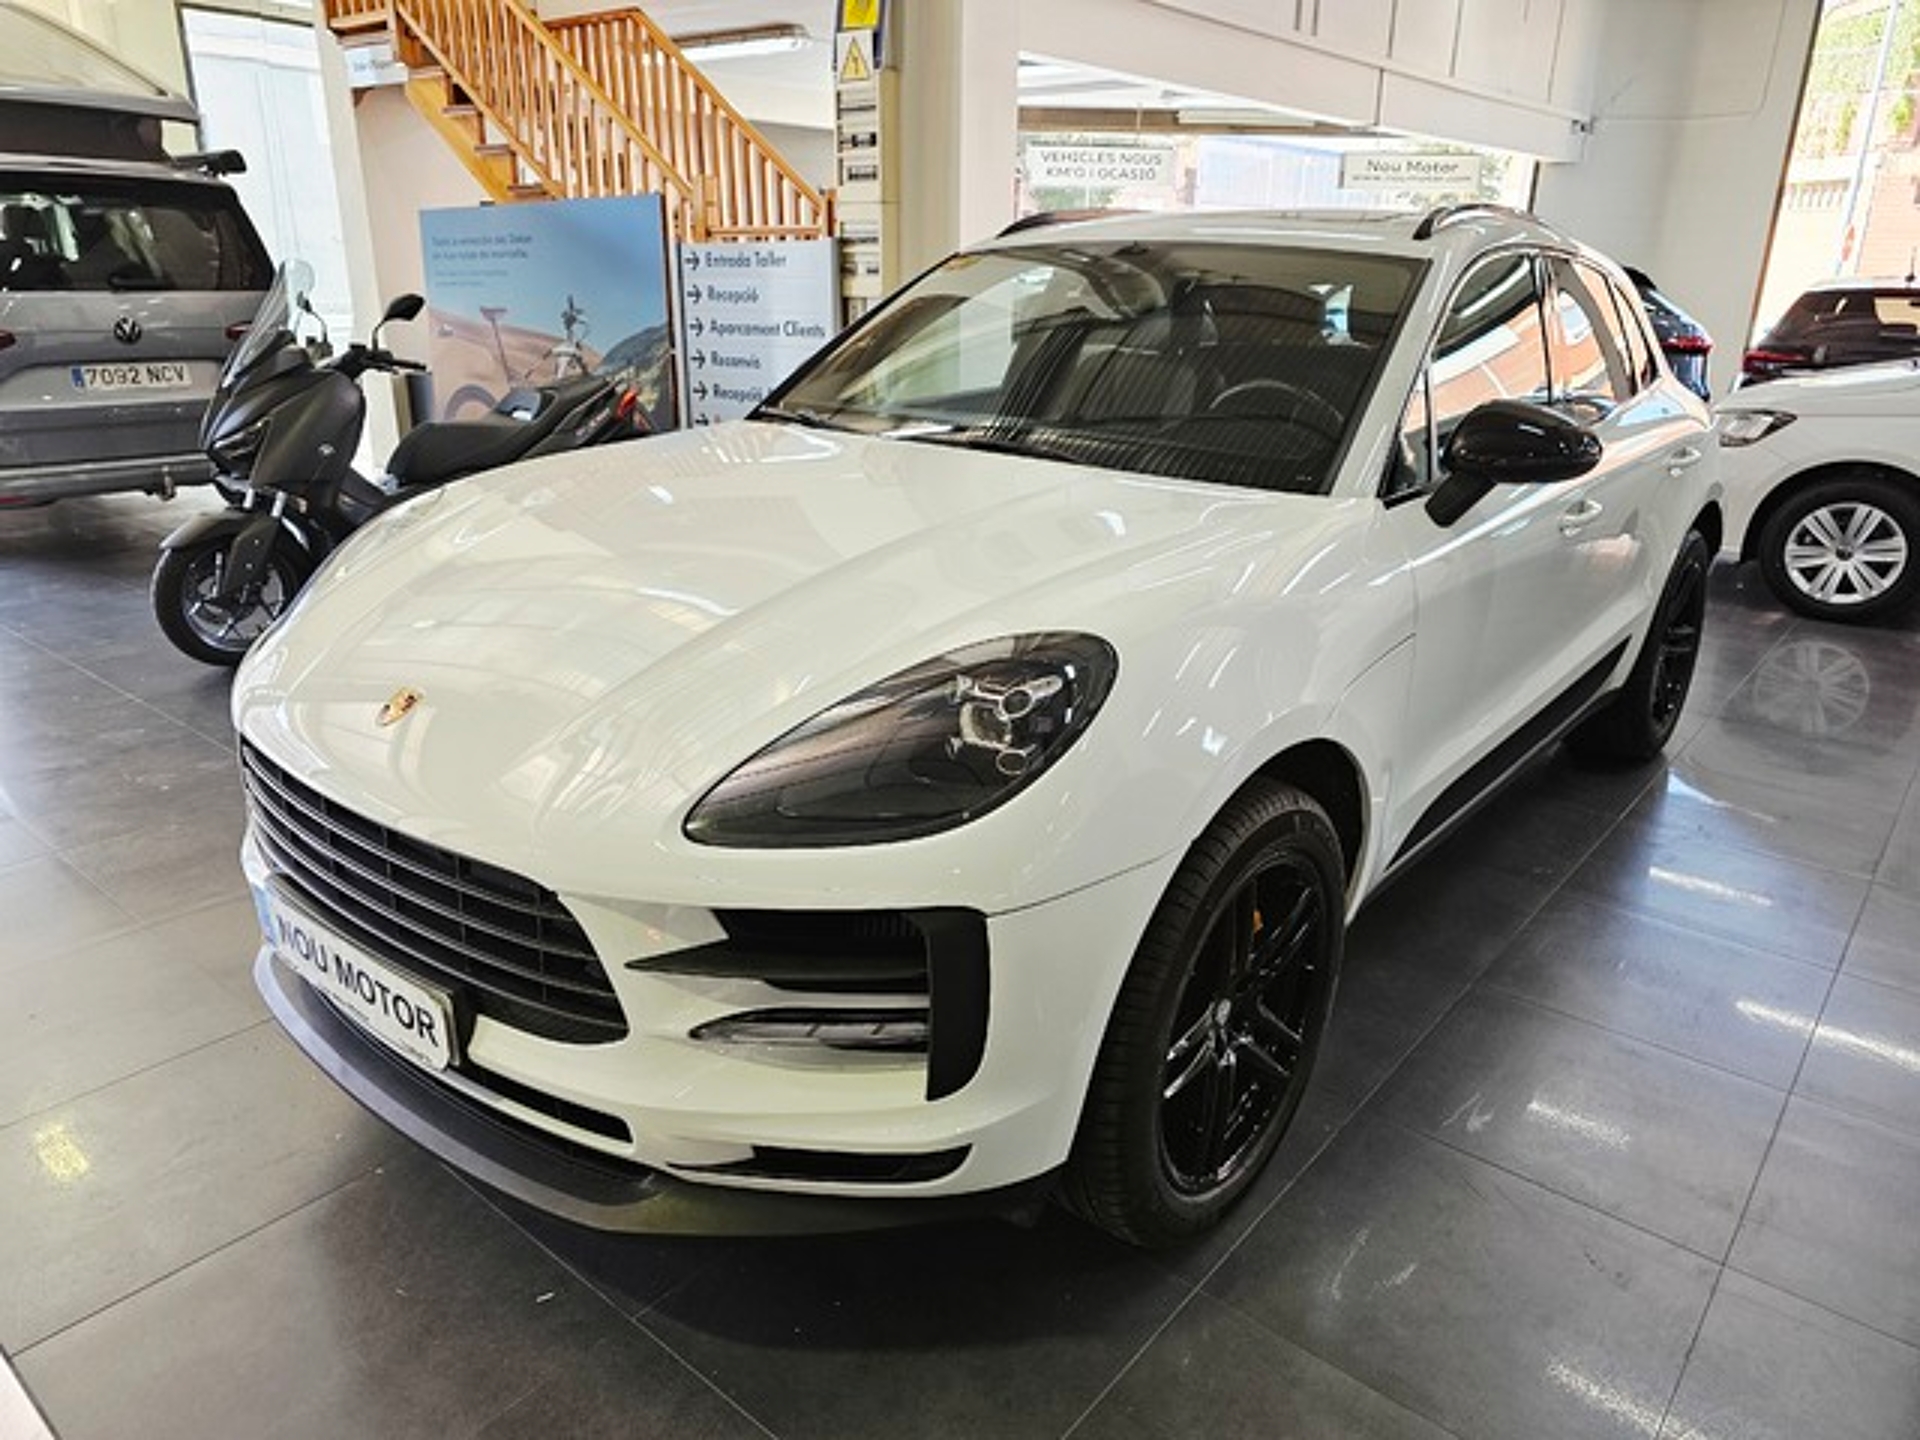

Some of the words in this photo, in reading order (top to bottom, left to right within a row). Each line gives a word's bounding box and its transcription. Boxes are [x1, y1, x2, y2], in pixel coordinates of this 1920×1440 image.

[1041, 151, 1116, 163] VEHICLES
[1119, 152, 1162, 165] NOUS
[1367, 159, 1401, 172] Nou
[1406, 160, 1458, 174] Motor
[705, 251, 751, 268] Entrada
[754, 251, 787, 268] Taller
[707, 285, 760, 305] Recepció
[710, 319, 781, 337] Aparcament
[783, 319, 826, 338] Clients
[711, 350, 761, 370] Recanvis
[85, 366, 142, 386] 7092
[146, 364, 184, 383] NCV
[275, 913, 328, 974] NOU
[334, 953, 440, 1049] MOTOR
